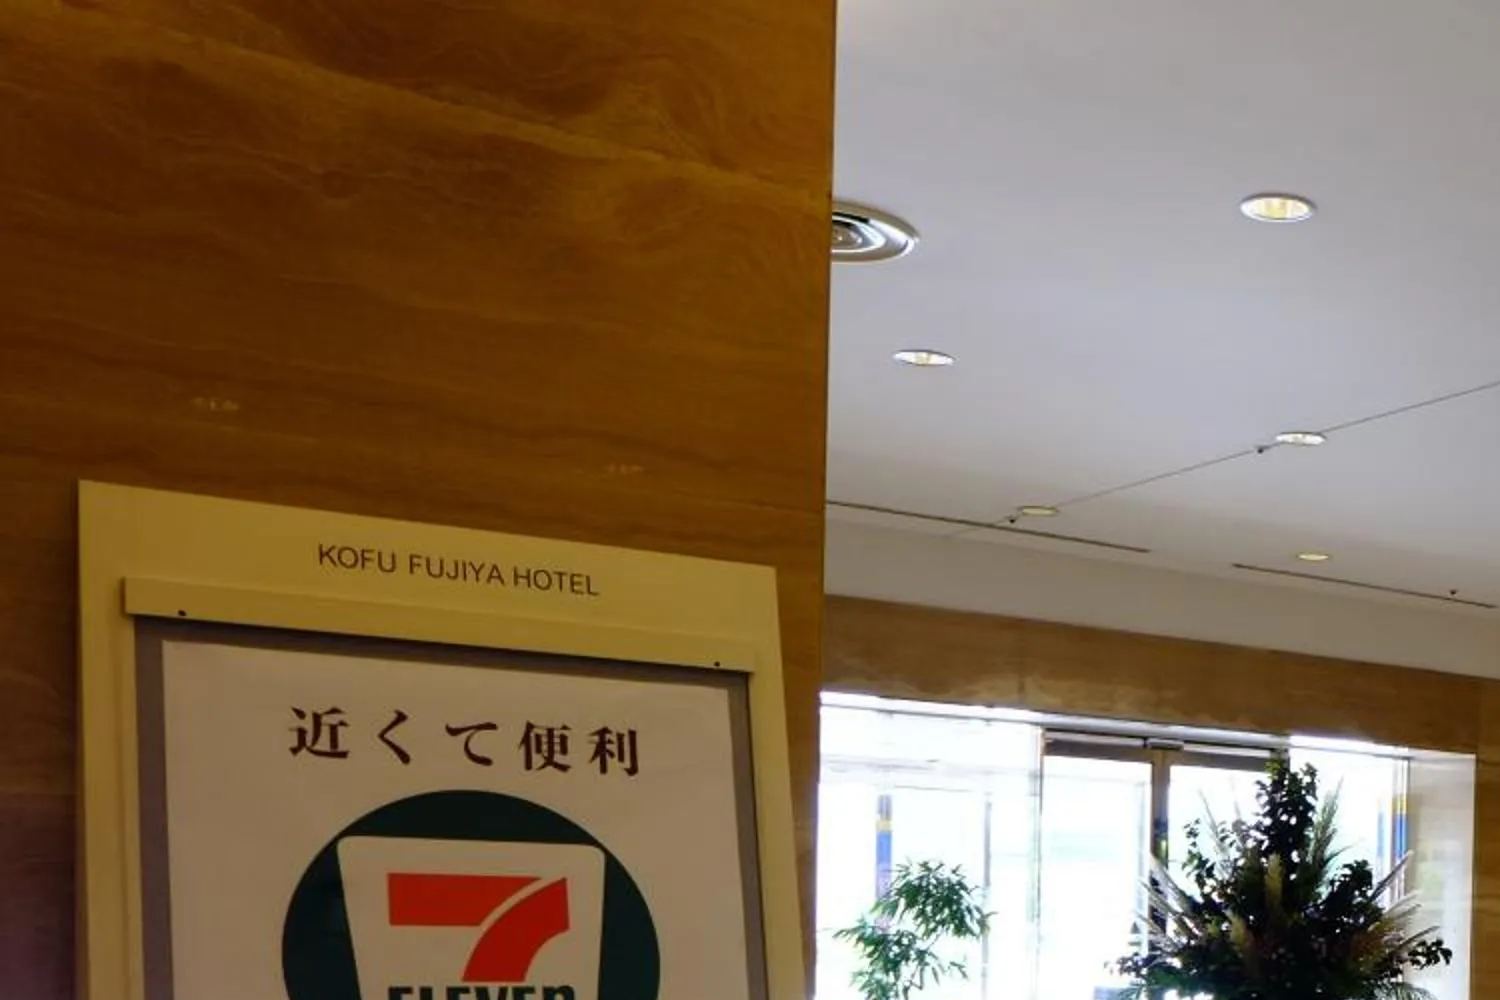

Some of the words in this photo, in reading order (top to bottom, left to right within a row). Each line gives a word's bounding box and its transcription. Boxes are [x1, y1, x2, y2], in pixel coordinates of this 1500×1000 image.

[318, 543, 397, 573] KOFU
[409, 554, 505, 586] FUJIYA
[513, 566, 600, 597] HOTEL
[289, 706, 640, 777] 近くて便利
